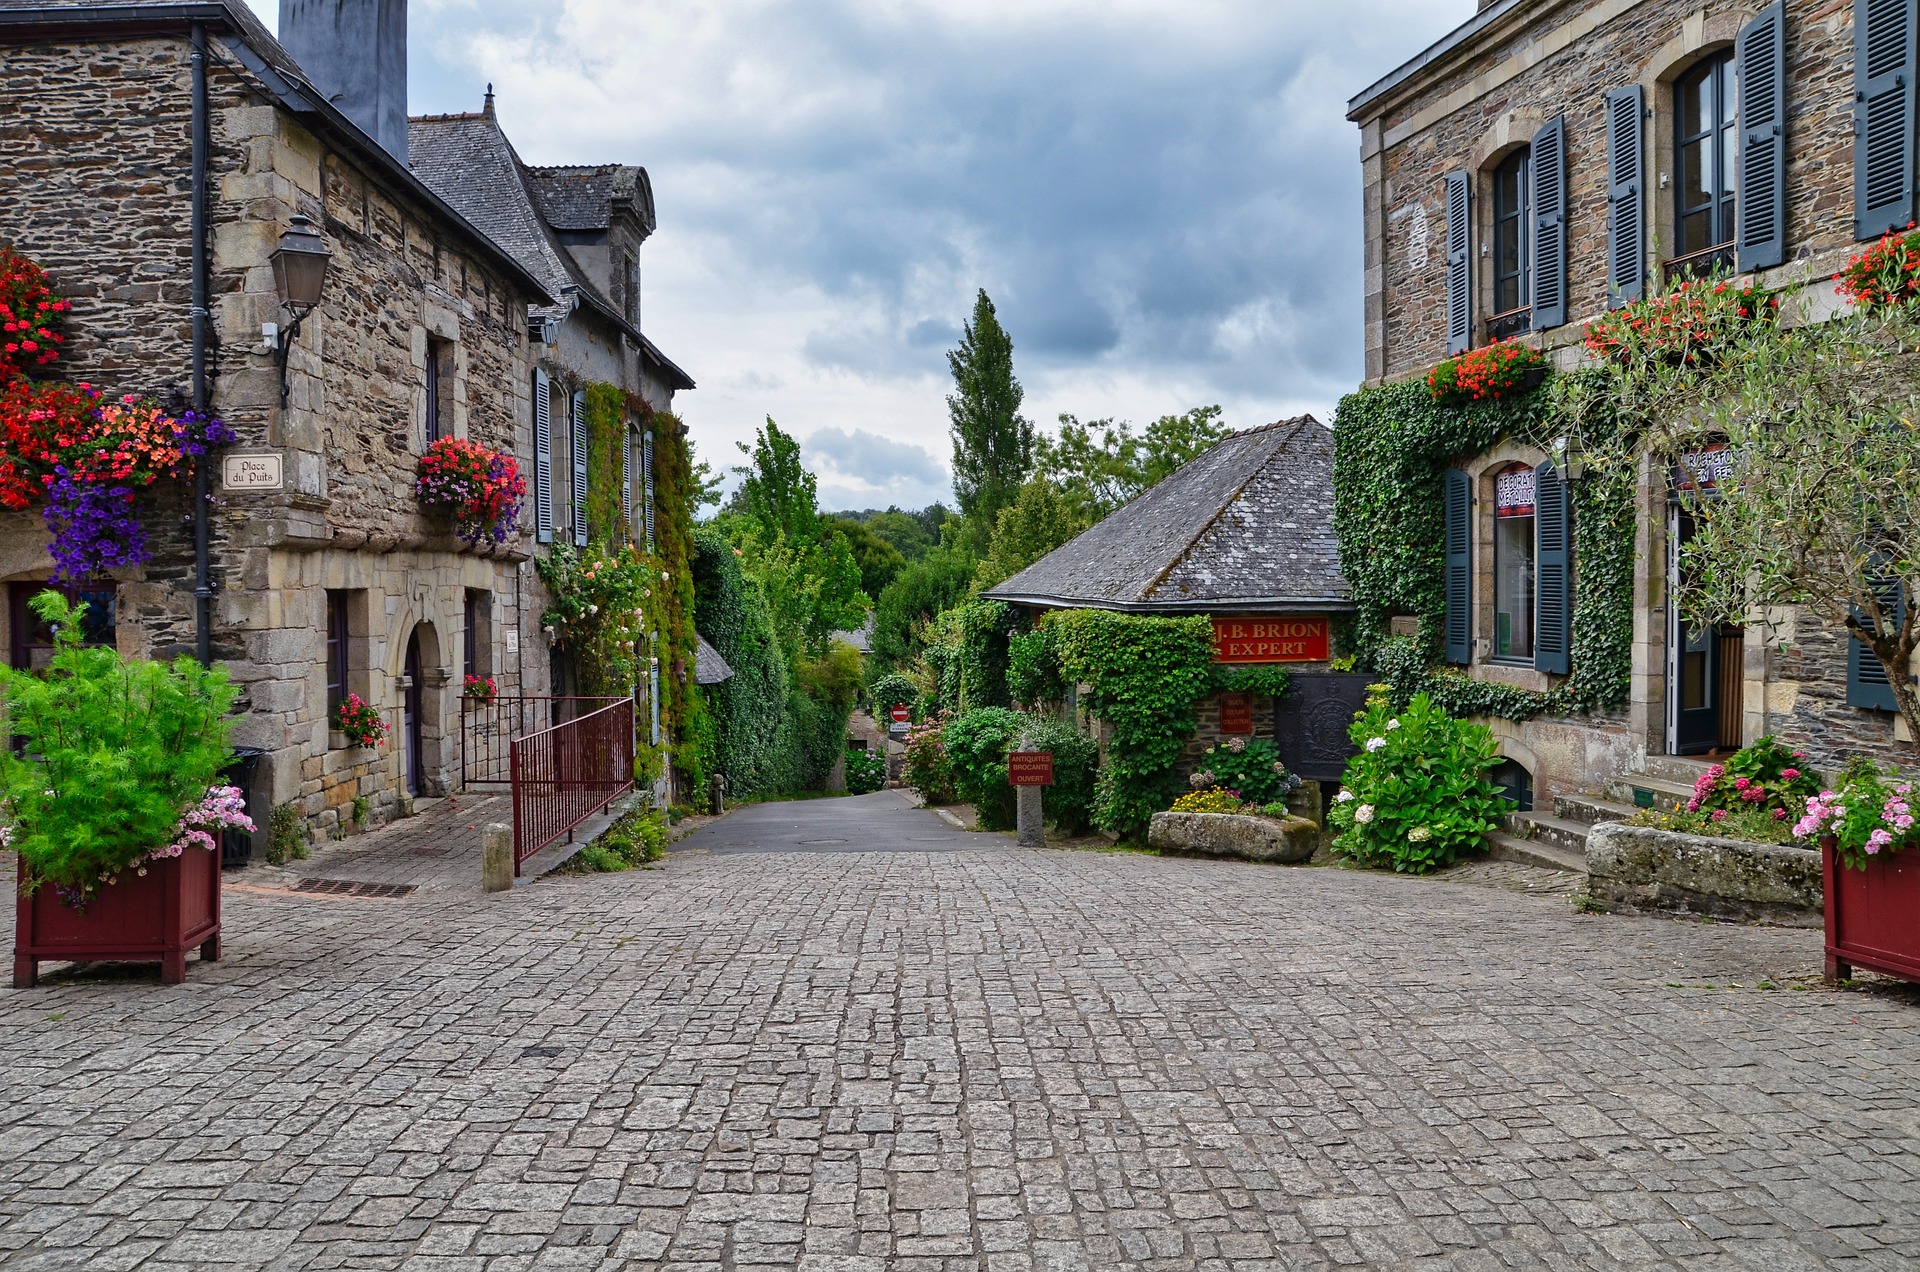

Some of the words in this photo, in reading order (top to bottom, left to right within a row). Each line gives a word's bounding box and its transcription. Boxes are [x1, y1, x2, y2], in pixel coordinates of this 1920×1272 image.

[240, 461, 265, 473] Place
[232, 473, 244, 482] du
[247, 472, 273, 484] Puits
[1215, 624, 1228, 644] J.
[1230, 624, 1248, 639] B.
[1251, 623, 1321, 639] BRION
[1228, 642, 1307, 656] EXPERT
[1011, 755, 1050, 763] ANTIQUITÉS
